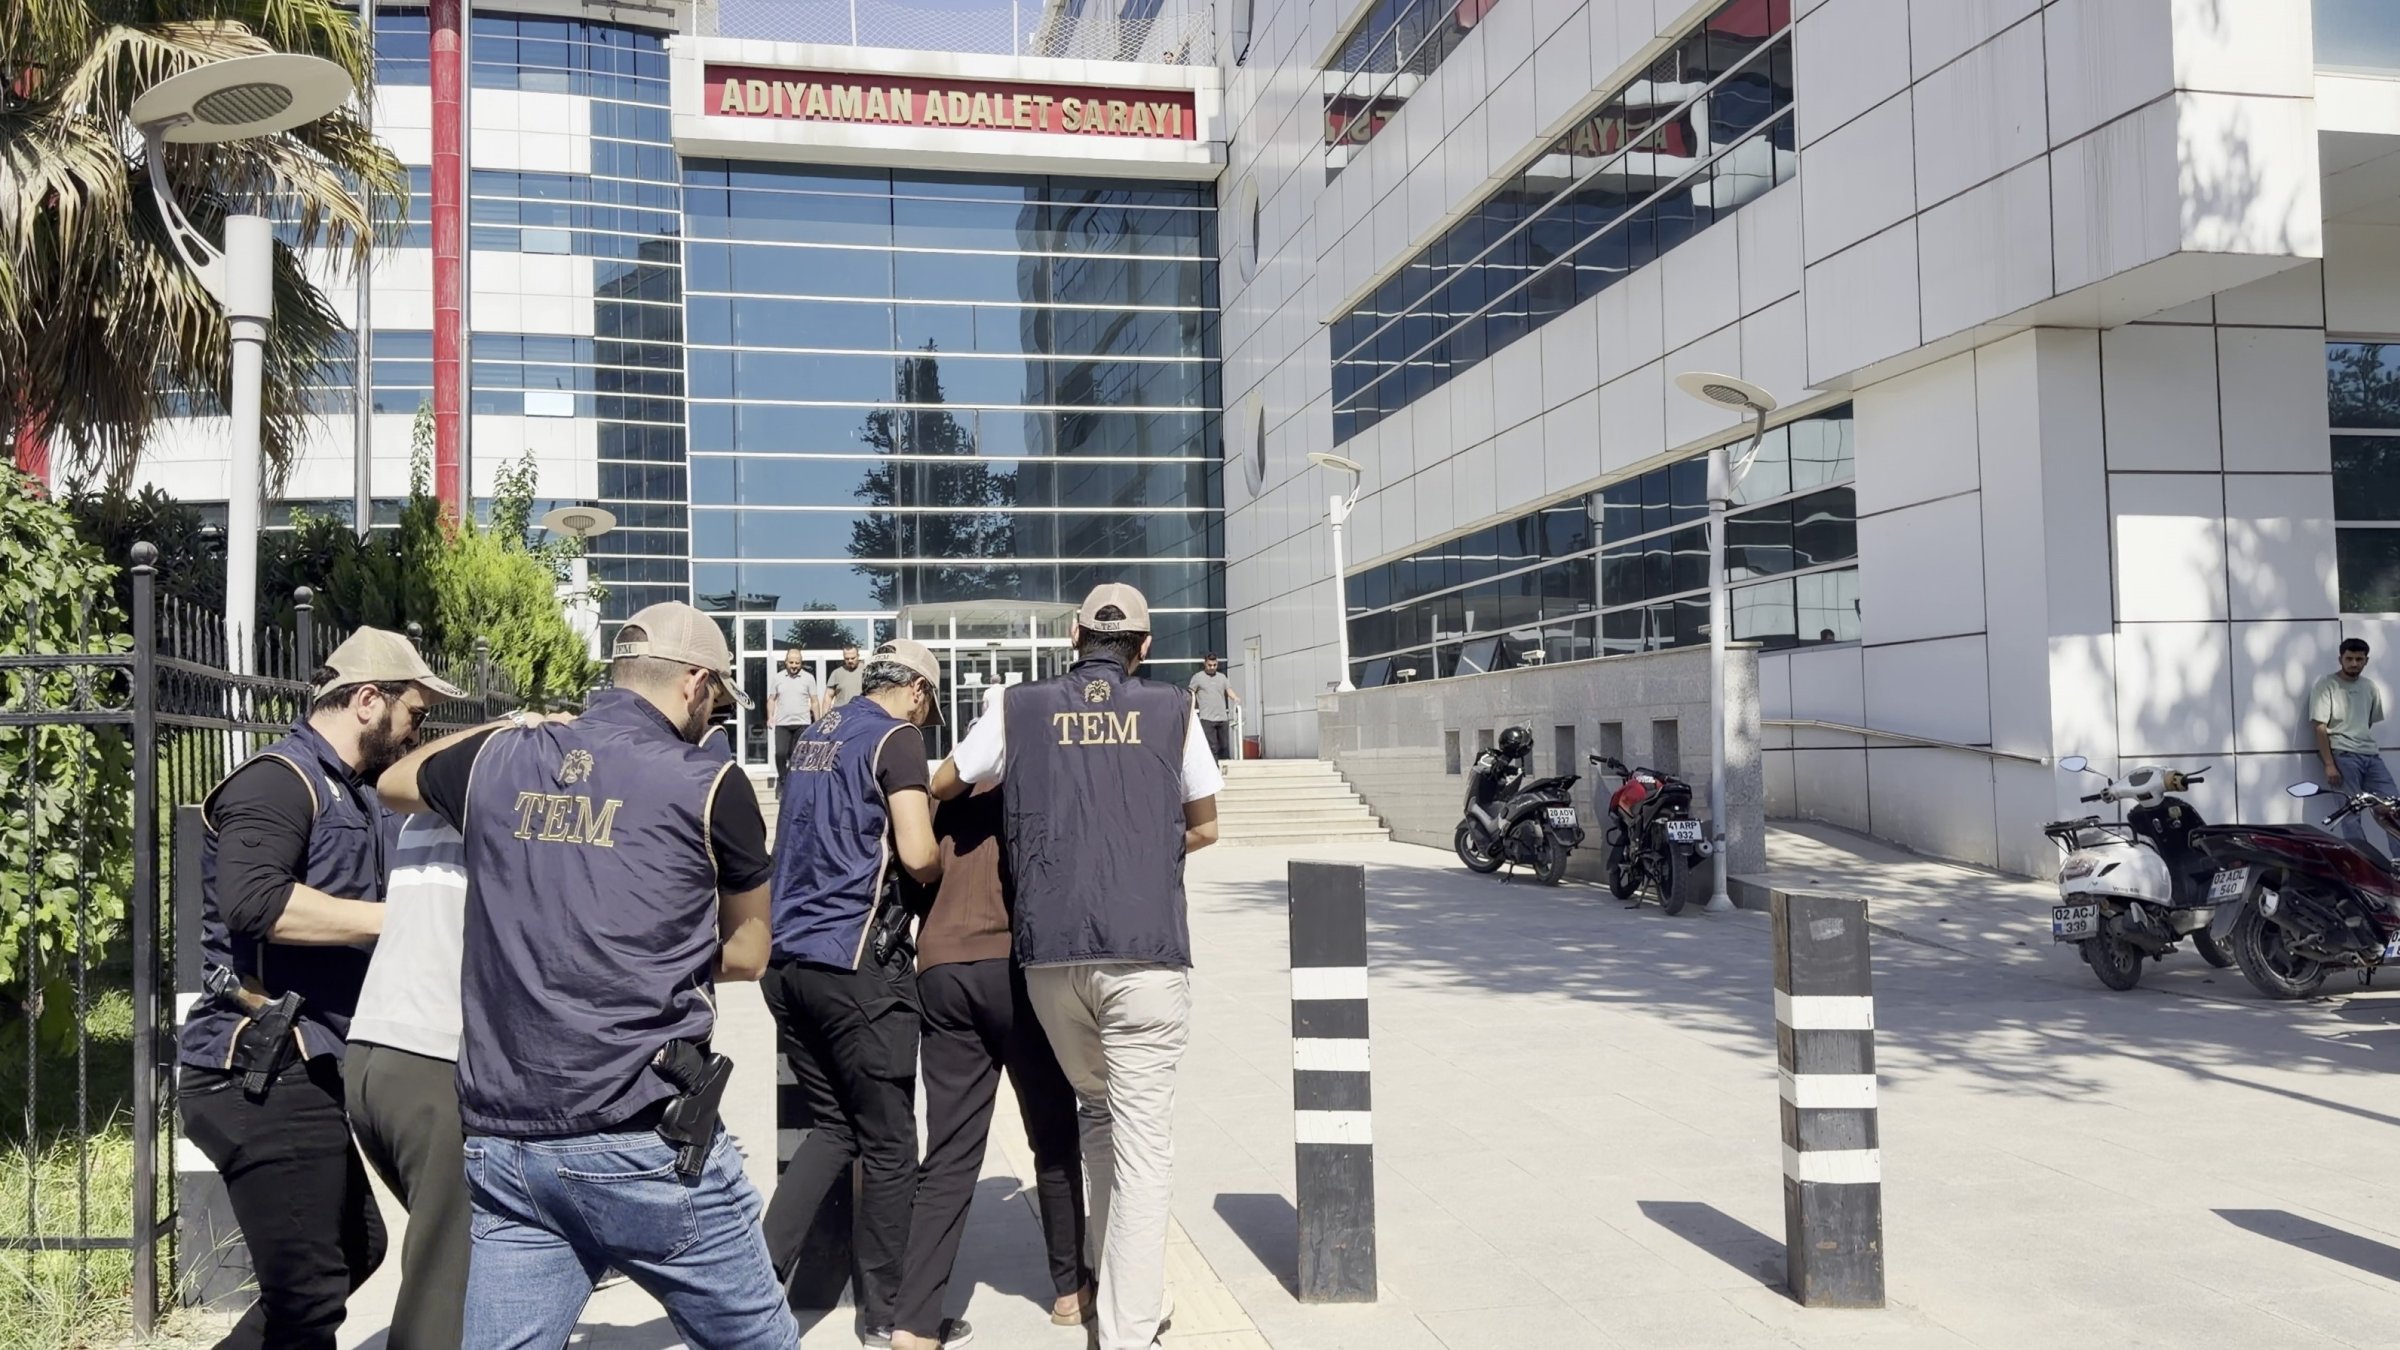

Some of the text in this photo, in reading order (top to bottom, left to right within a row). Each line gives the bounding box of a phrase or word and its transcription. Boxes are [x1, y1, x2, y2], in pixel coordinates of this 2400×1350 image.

[720, 78, 1183, 138] ADIYAMAN ADALET SARAYI
[1100, 621, 1120, 630] TEM
[1053, 711, 1142, 745] TEM
[786, 740, 844, 771] TEM
[513, 791, 623, 847] TEM
[1668, 821, 1697, 830] 41 ARP
[1677, 831, 1693, 839] 932
[2214, 873, 2226, 884] 02
[2055, 905, 2096, 920] 02 ACJ
[2066, 921, 2087, 933] 339
